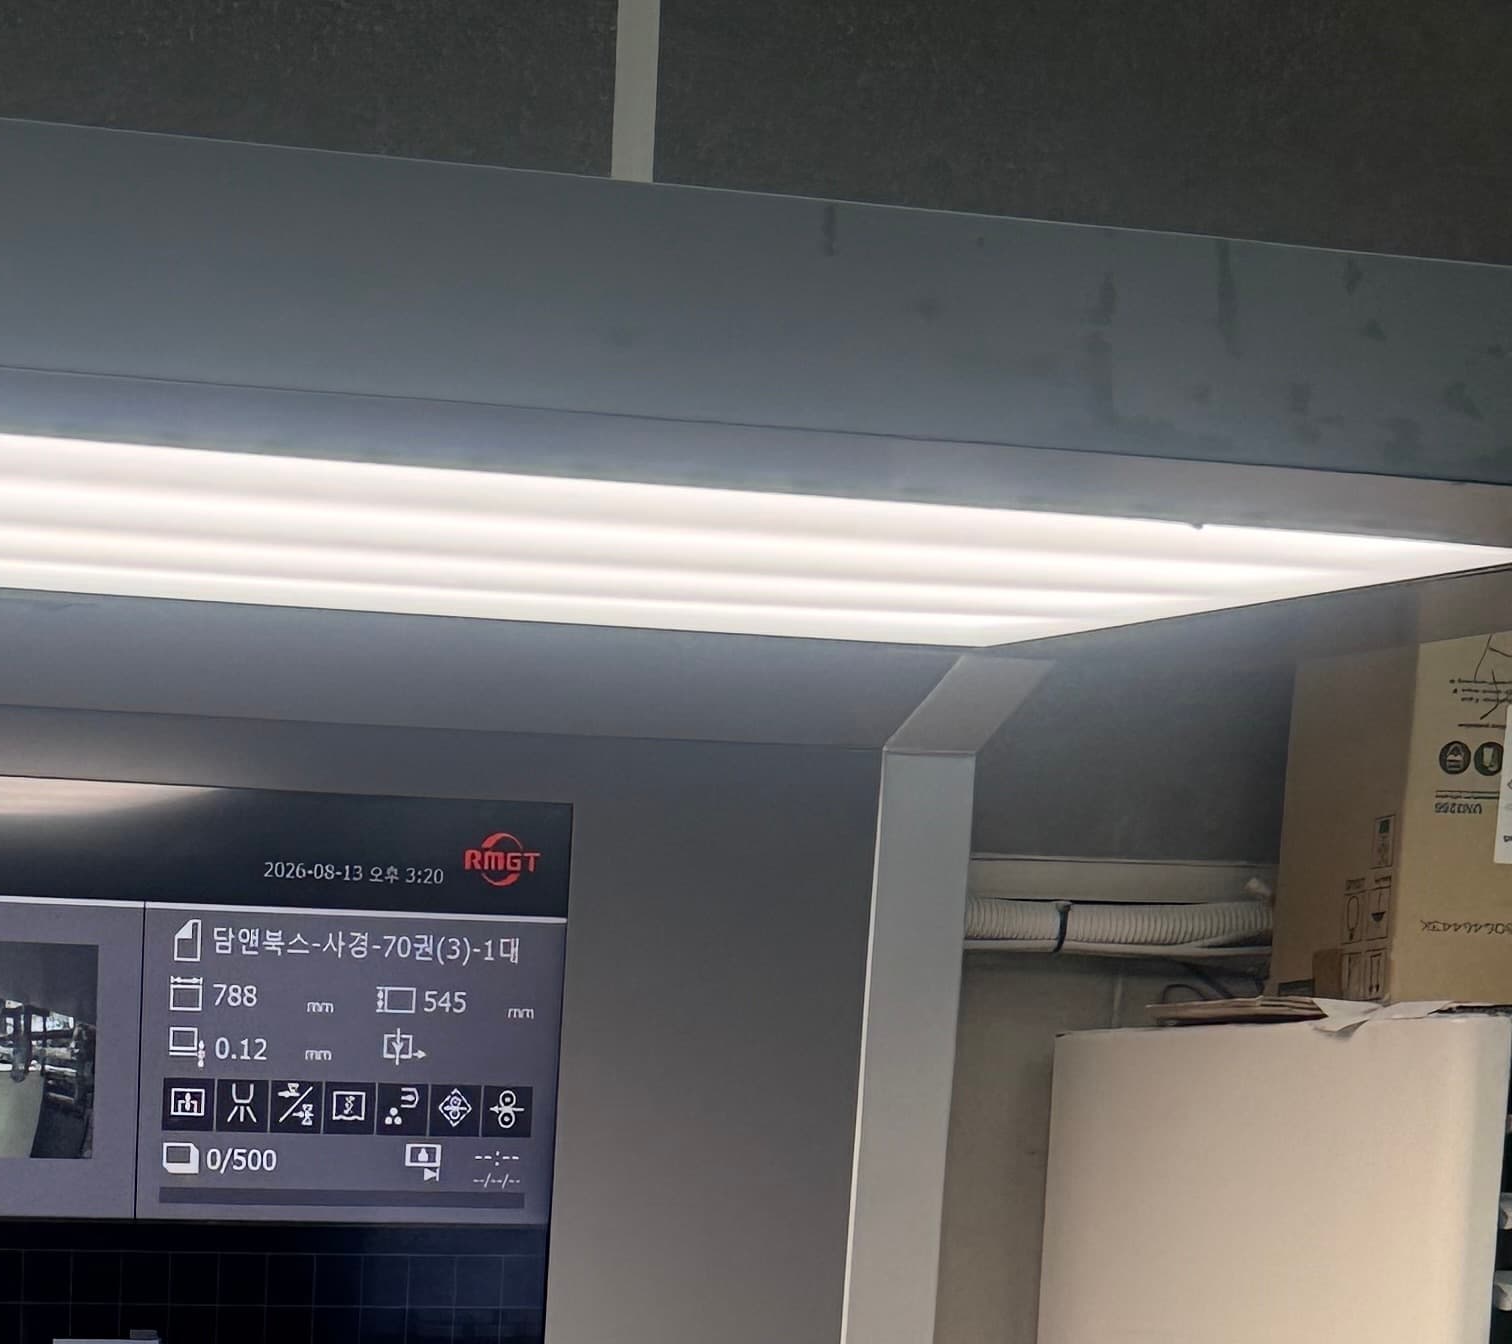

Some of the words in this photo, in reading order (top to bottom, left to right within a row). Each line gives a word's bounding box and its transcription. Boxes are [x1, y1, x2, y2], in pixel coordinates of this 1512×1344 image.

[263, 861, 363, 882] 2026-08-13
[369, 865, 400, 884] 오후
[405, 867, 444, 885] 3:20
[464, 847, 541, 873] RMGT
[213, 927, 520, 964] 담앤북스-사경-70권(3)-1대
[213, 984, 258, 1007] 788
[307, 1001, 334, 1014] mm
[424, 991, 467, 1013] 545
[507, 1006, 534, 1019] mm
[215, 1037, 268, 1061] 0.12
[305, 1048, 332, 1061] mm
[206, 1147, 277, 1173] 0/500
